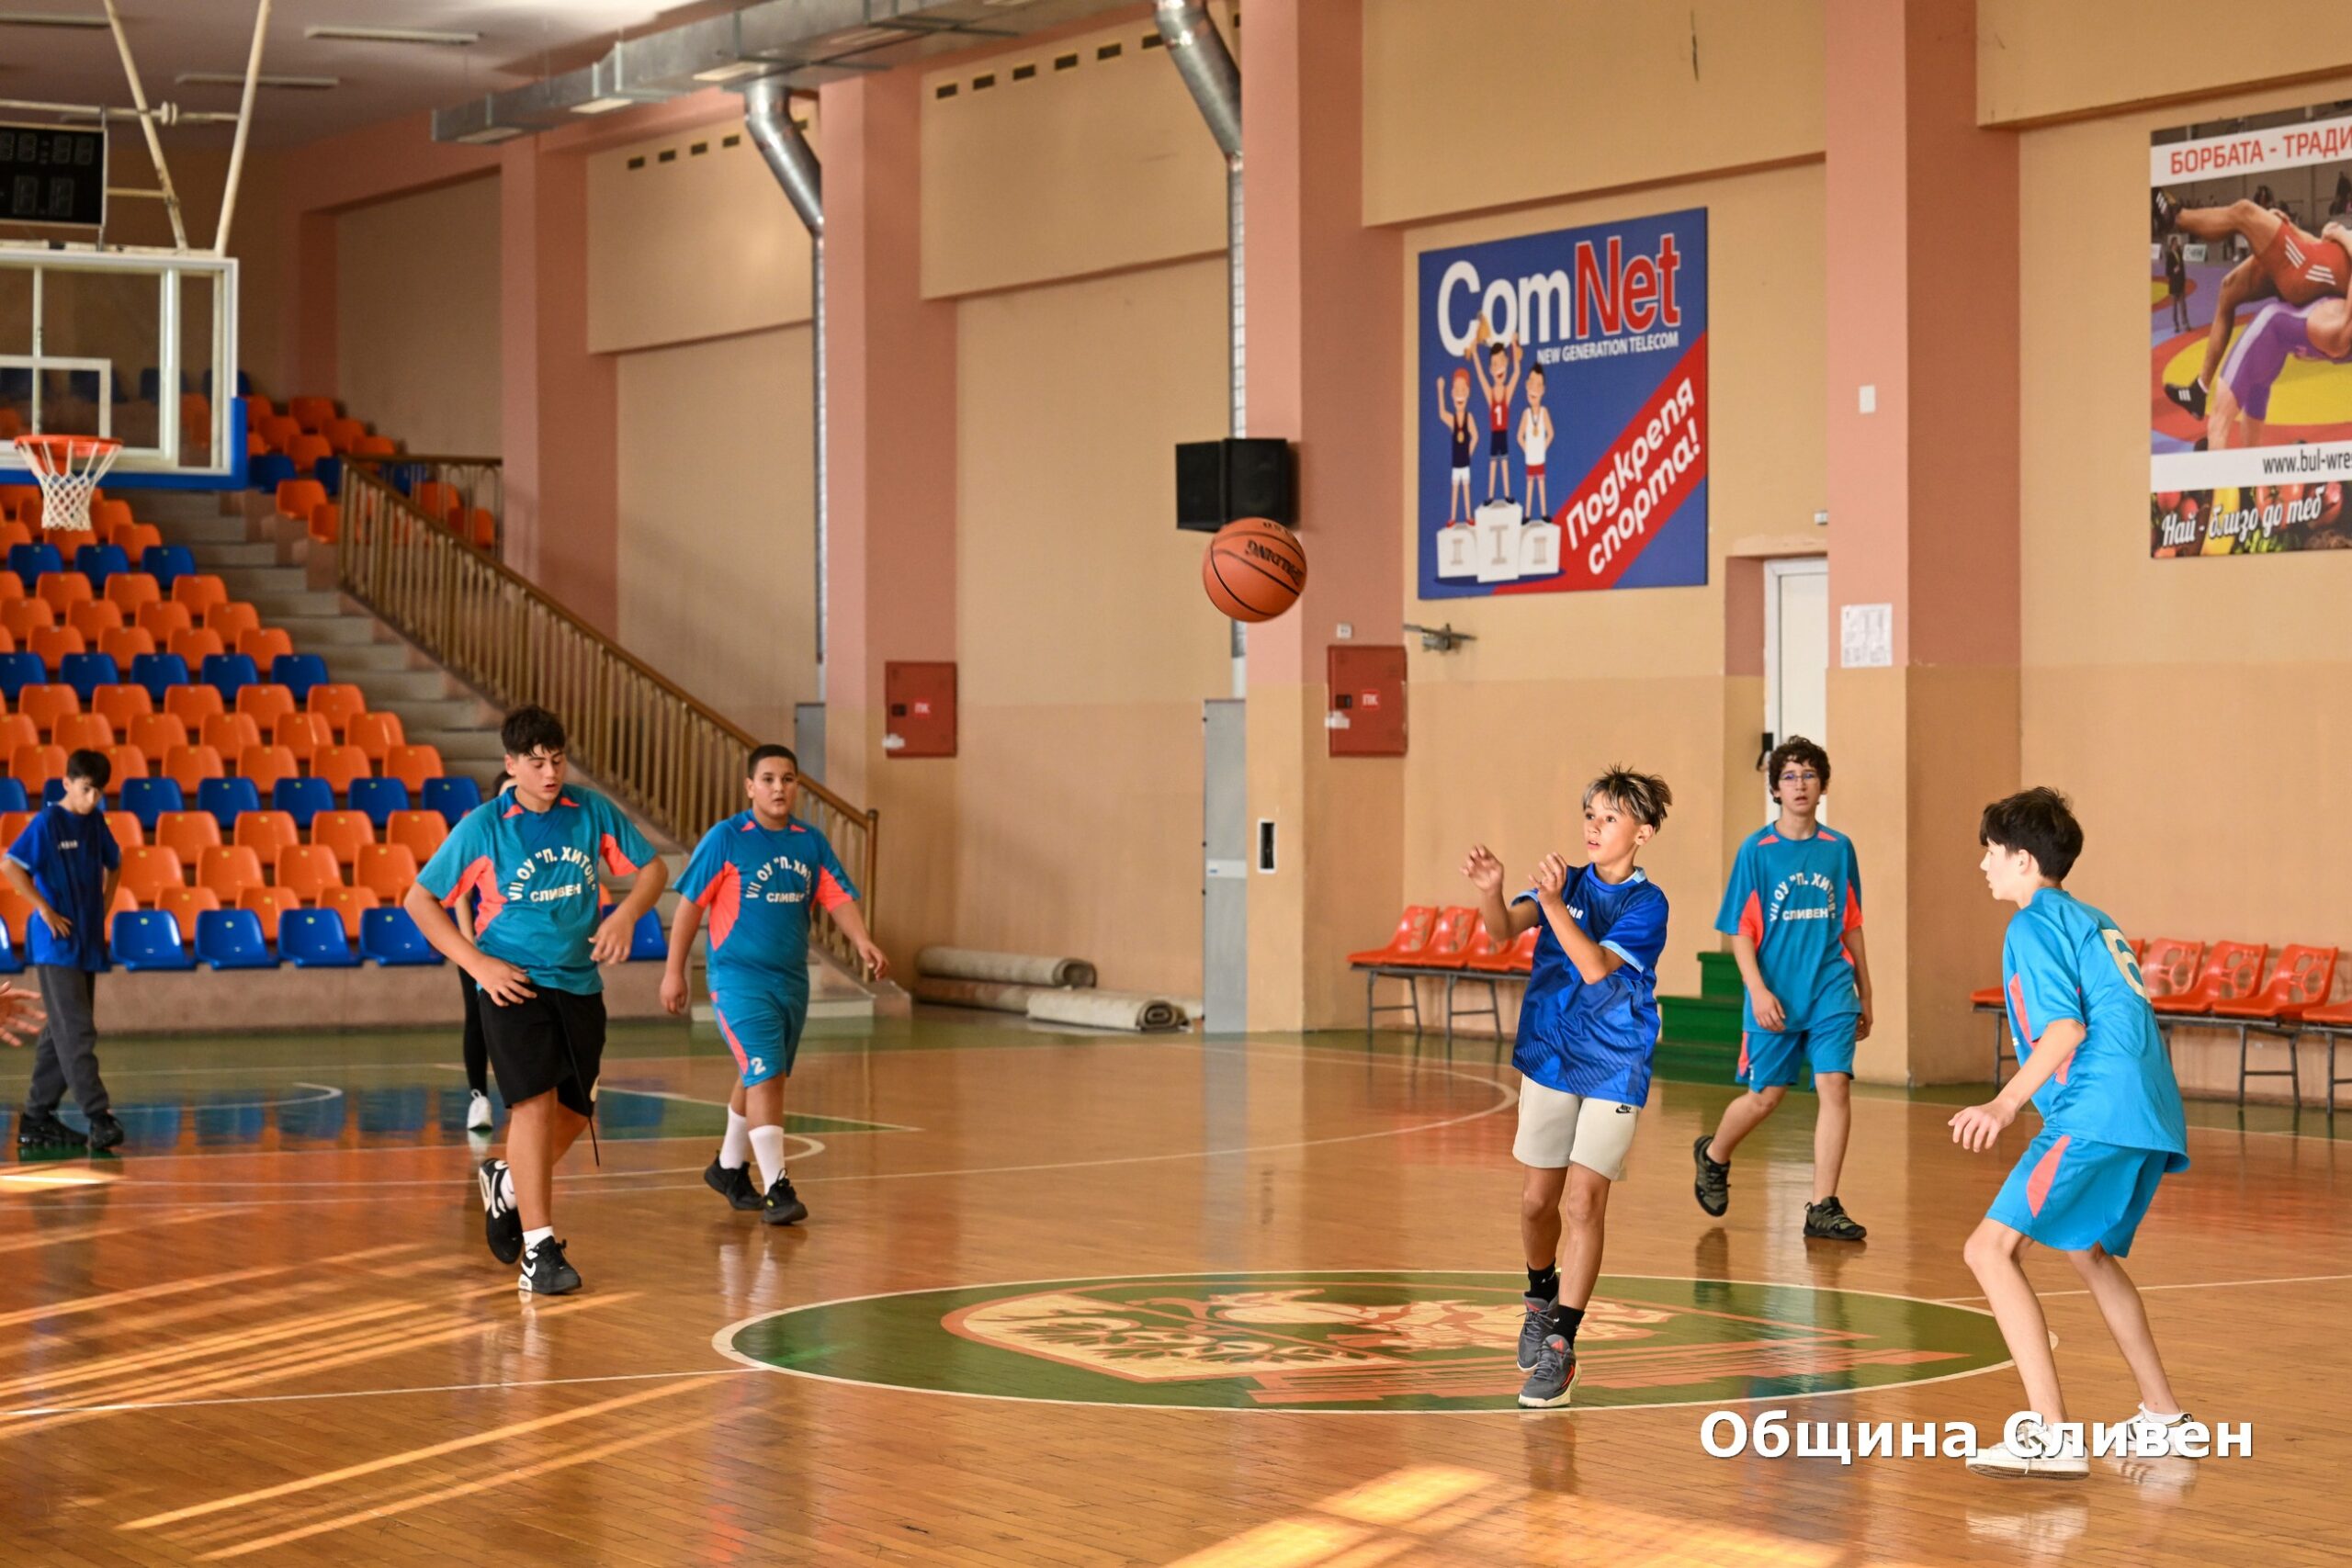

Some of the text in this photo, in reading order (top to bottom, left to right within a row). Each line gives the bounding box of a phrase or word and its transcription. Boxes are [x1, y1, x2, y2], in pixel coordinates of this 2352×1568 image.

[2171, 139, 2264, 175] БОРБАТА
[2283, 125, 2352, 159] ТРАДИ
[1437, 232, 1681, 357] ComNet
[1536, 331, 1679, 365] NEW GENERATION TELECOM
[1494, 405, 1502, 426] 1
[1566, 377, 1695, 550] Подкрепя
[2263, 446, 2352, 474] www.bul-wre
[1588, 417, 1702, 575] спорта!
[2162, 513, 2197, 547] Най
[2209, 504, 2258, 543] близо
[2262, 505, 2282, 537] до
[2287, 486, 2325, 524] теб
[516, 858, 536, 880] ОУ
[756, 863, 773, 882] ОУ
[529, 883, 582, 902] СЛИВЕН
[1774, 882, 1790, 901] ОУ
[1782, 908, 1829, 921] СЛИВЕН
[750, 1056, 766, 1076] 2
